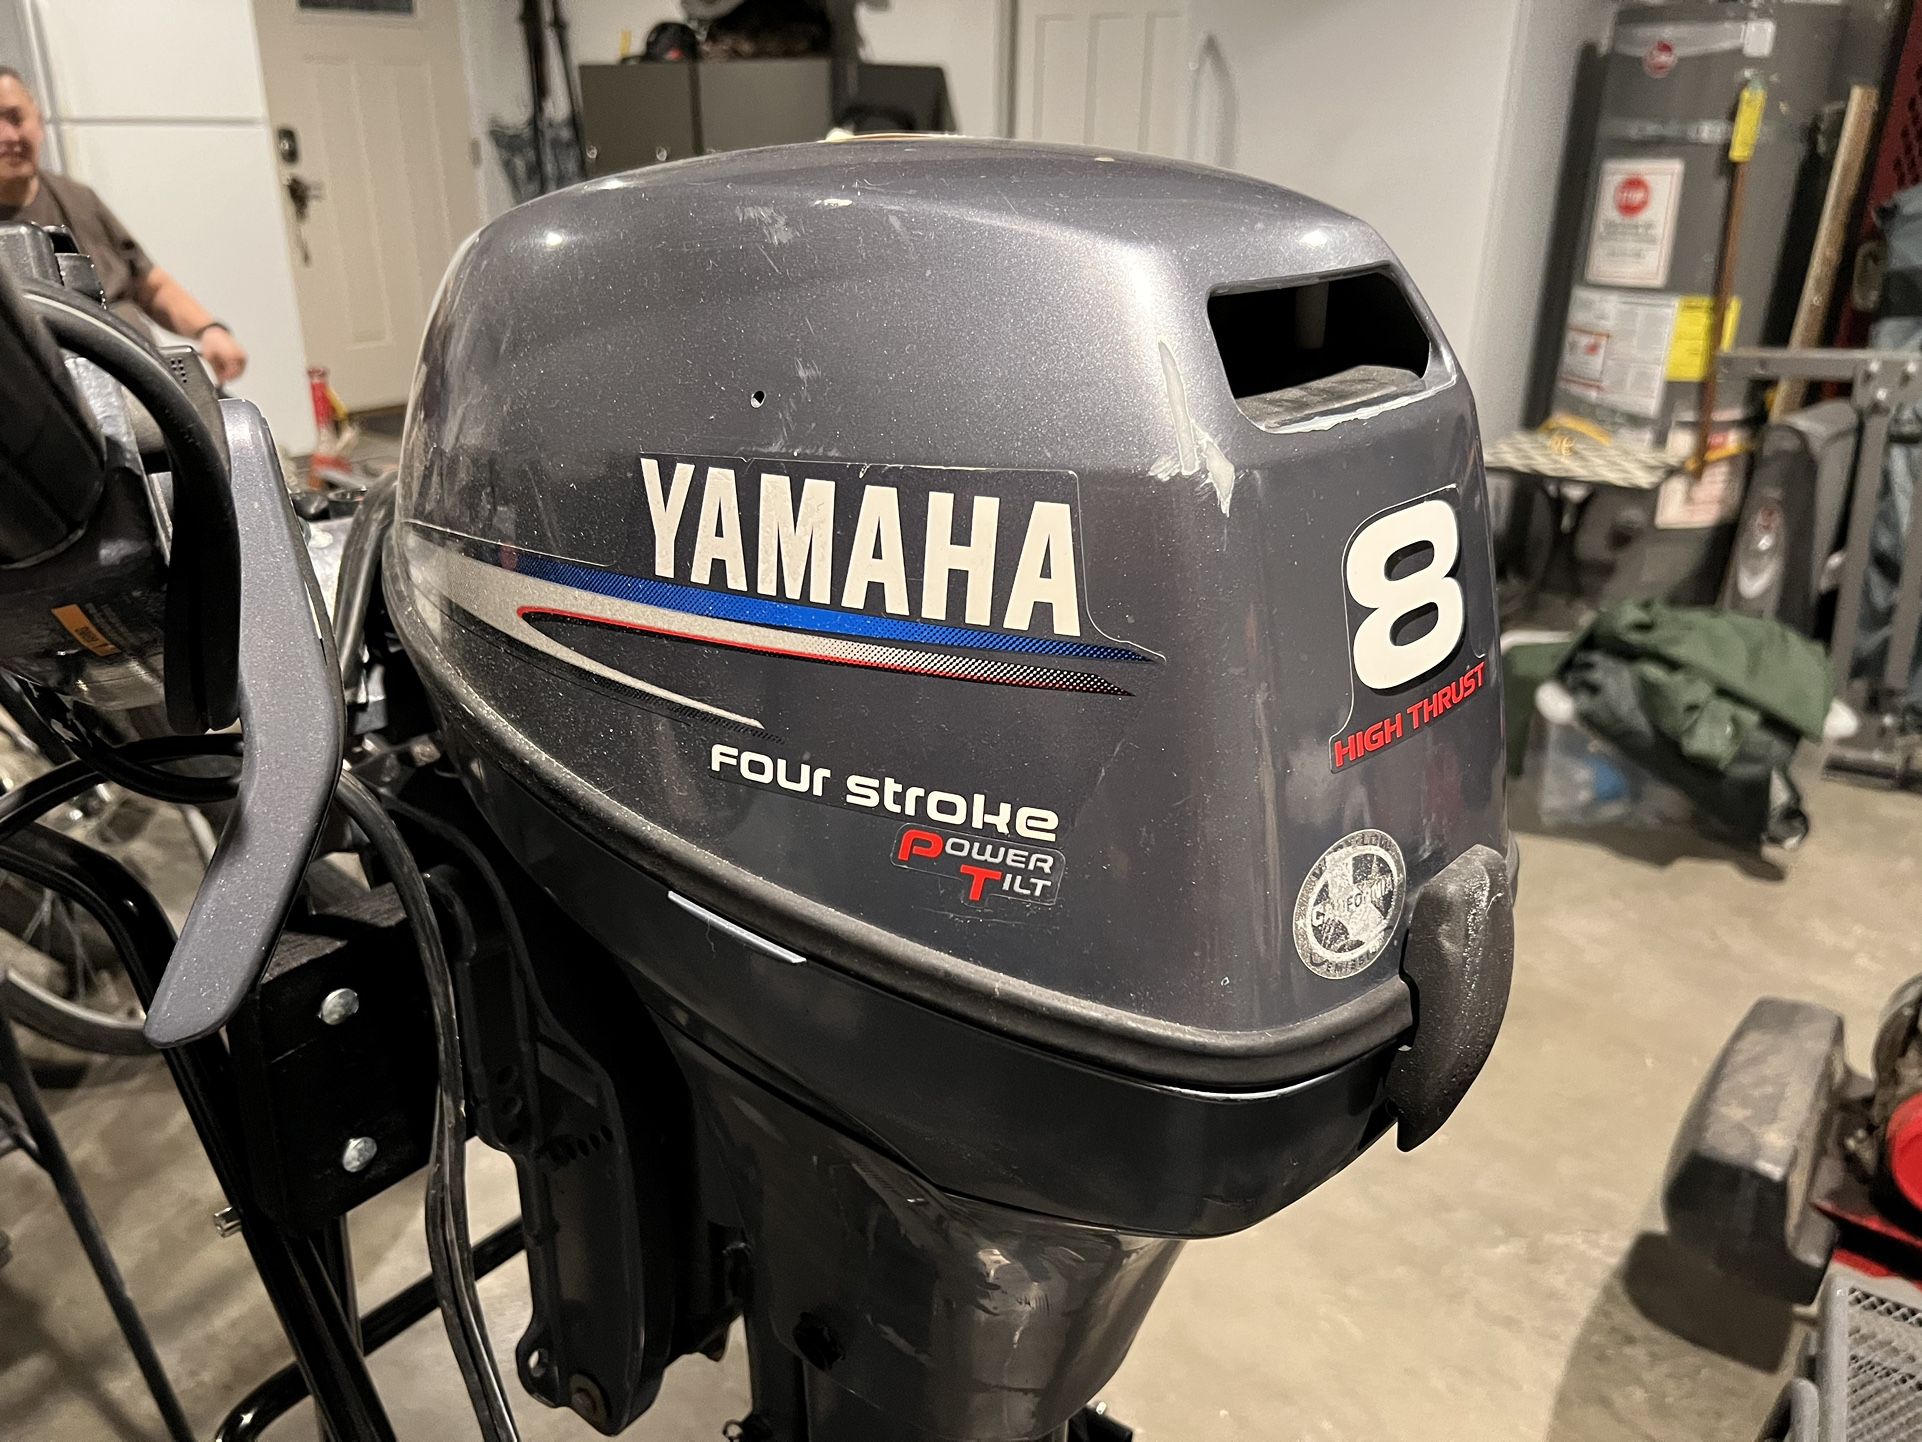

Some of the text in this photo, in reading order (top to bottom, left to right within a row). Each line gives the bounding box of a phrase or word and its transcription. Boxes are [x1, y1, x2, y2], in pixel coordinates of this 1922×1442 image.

[640, 458, 1081, 637] YAMAHA
[1346, 499, 1464, 691] 8
[1334, 661, 1486, 768] HIGH THRUST
[897, 829, 1055, 874] POWER
[959, 864, 1053, 902] TILT
